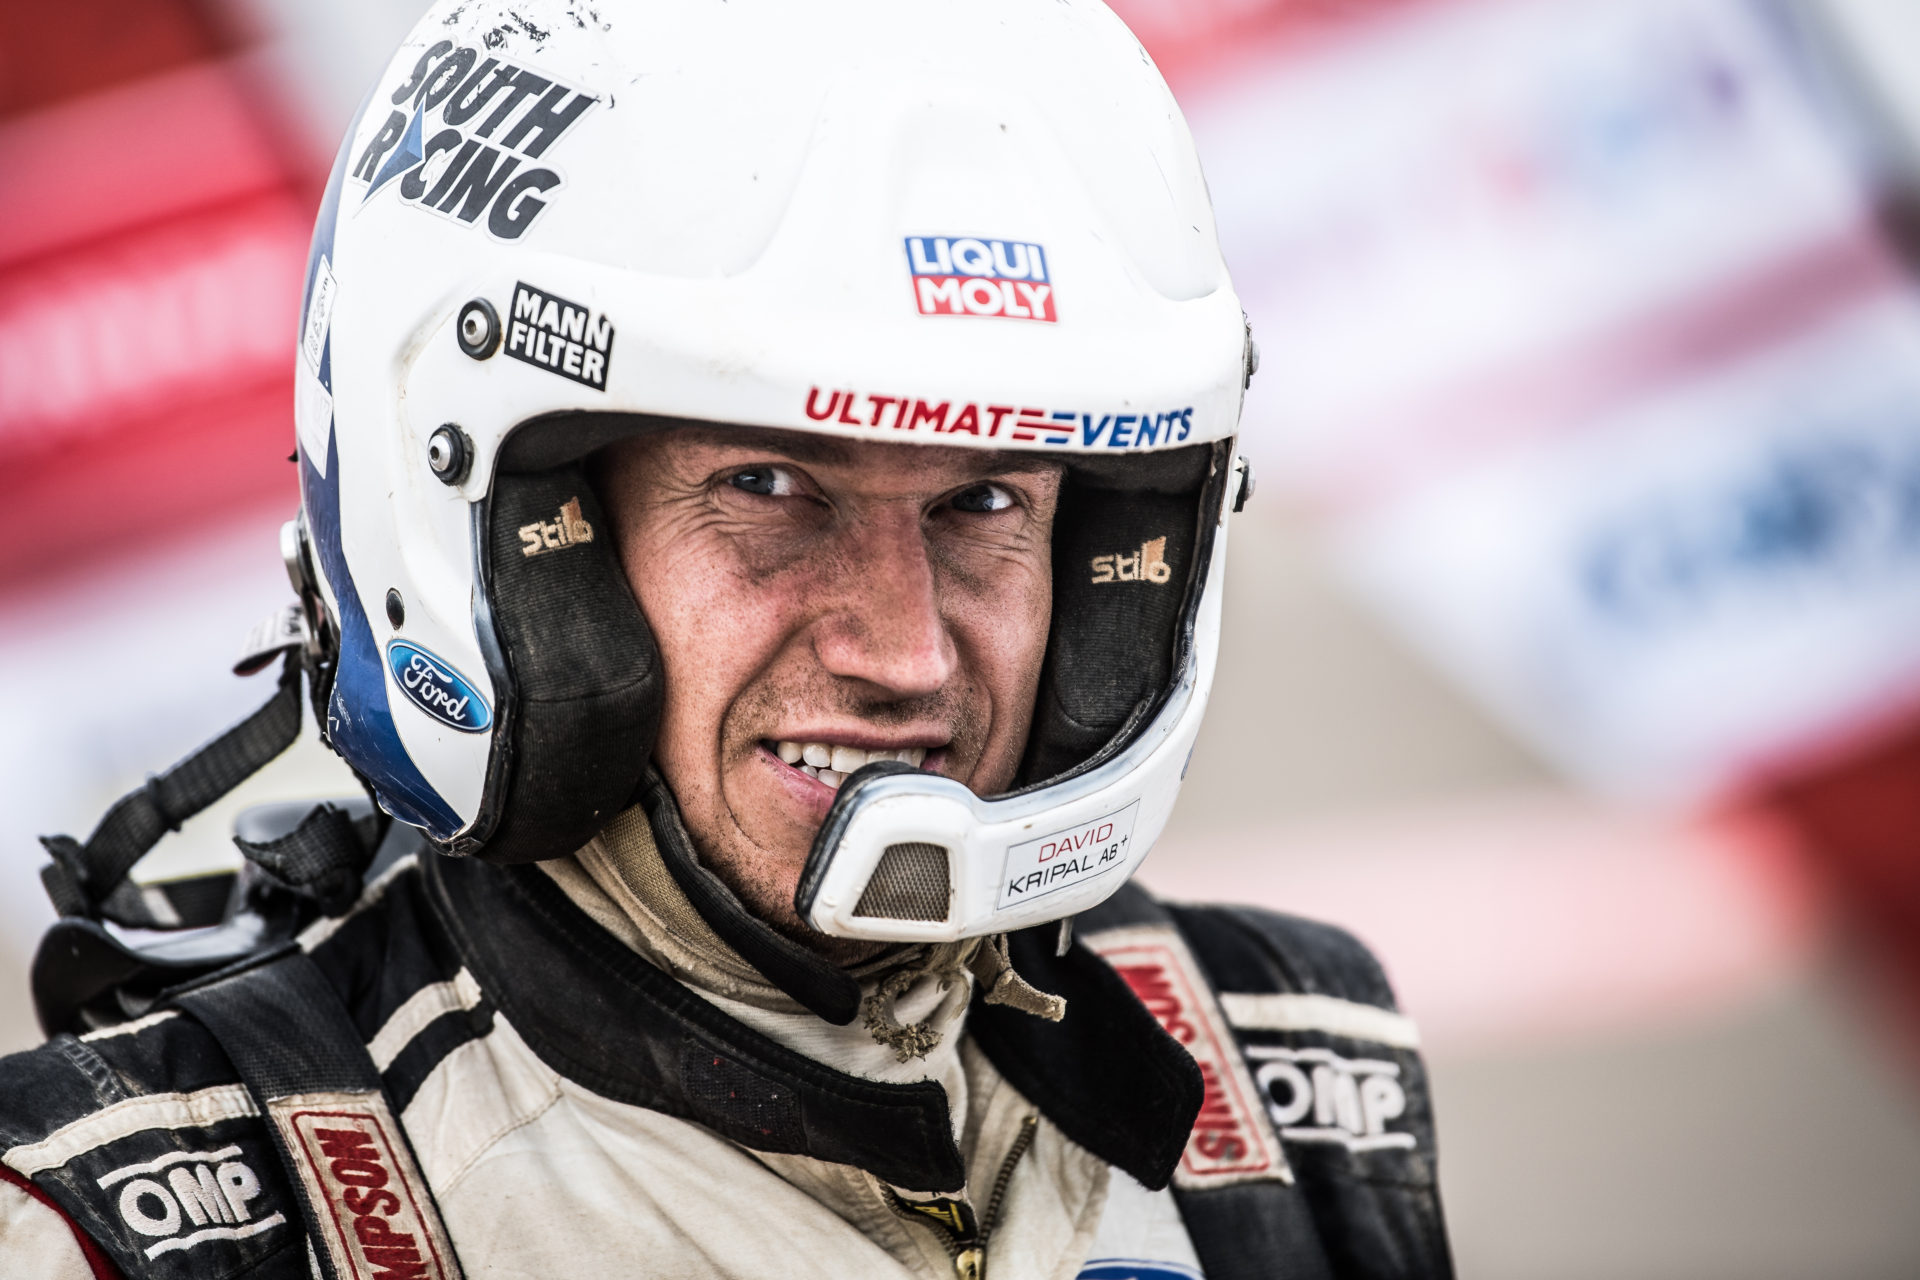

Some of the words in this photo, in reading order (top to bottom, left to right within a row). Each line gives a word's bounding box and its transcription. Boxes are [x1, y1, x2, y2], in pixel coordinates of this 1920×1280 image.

[391, 40, 599, 159] SOUTH
[911, 238, 1045, 280] LIQUI
[515, 288, 613, 352] MANN
[918, 277, 1050, 319] MOLY
[510, 320, 605, 384] FILTER
[404, 653, 468, 722] Ford
[1038, 822, 1113, 863] DAVID
[1007, 855, 1094, 897] KRIPAL
[1257, 1062, 1406, 1136] OMP
[119, 1161, 260, 1236] OMP
